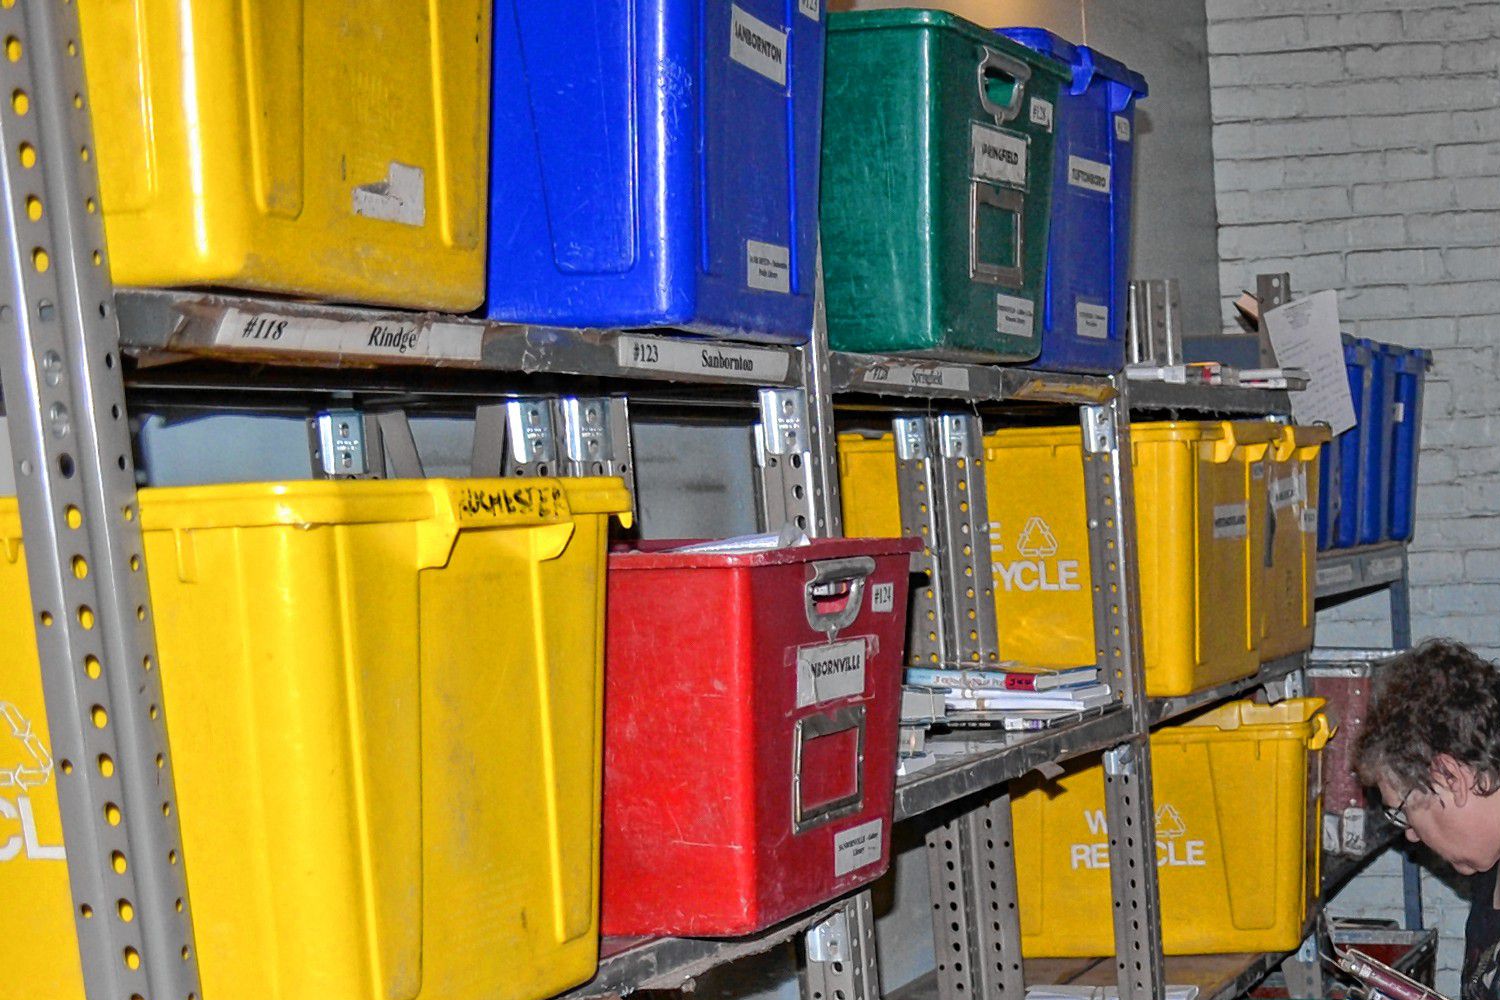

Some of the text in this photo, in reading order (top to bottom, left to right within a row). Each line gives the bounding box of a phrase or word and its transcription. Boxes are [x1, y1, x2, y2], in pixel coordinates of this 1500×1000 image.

[242, 316, 417, 353] #118 Rindge
[633, 341, 753, 372] #123 Sanbornton
